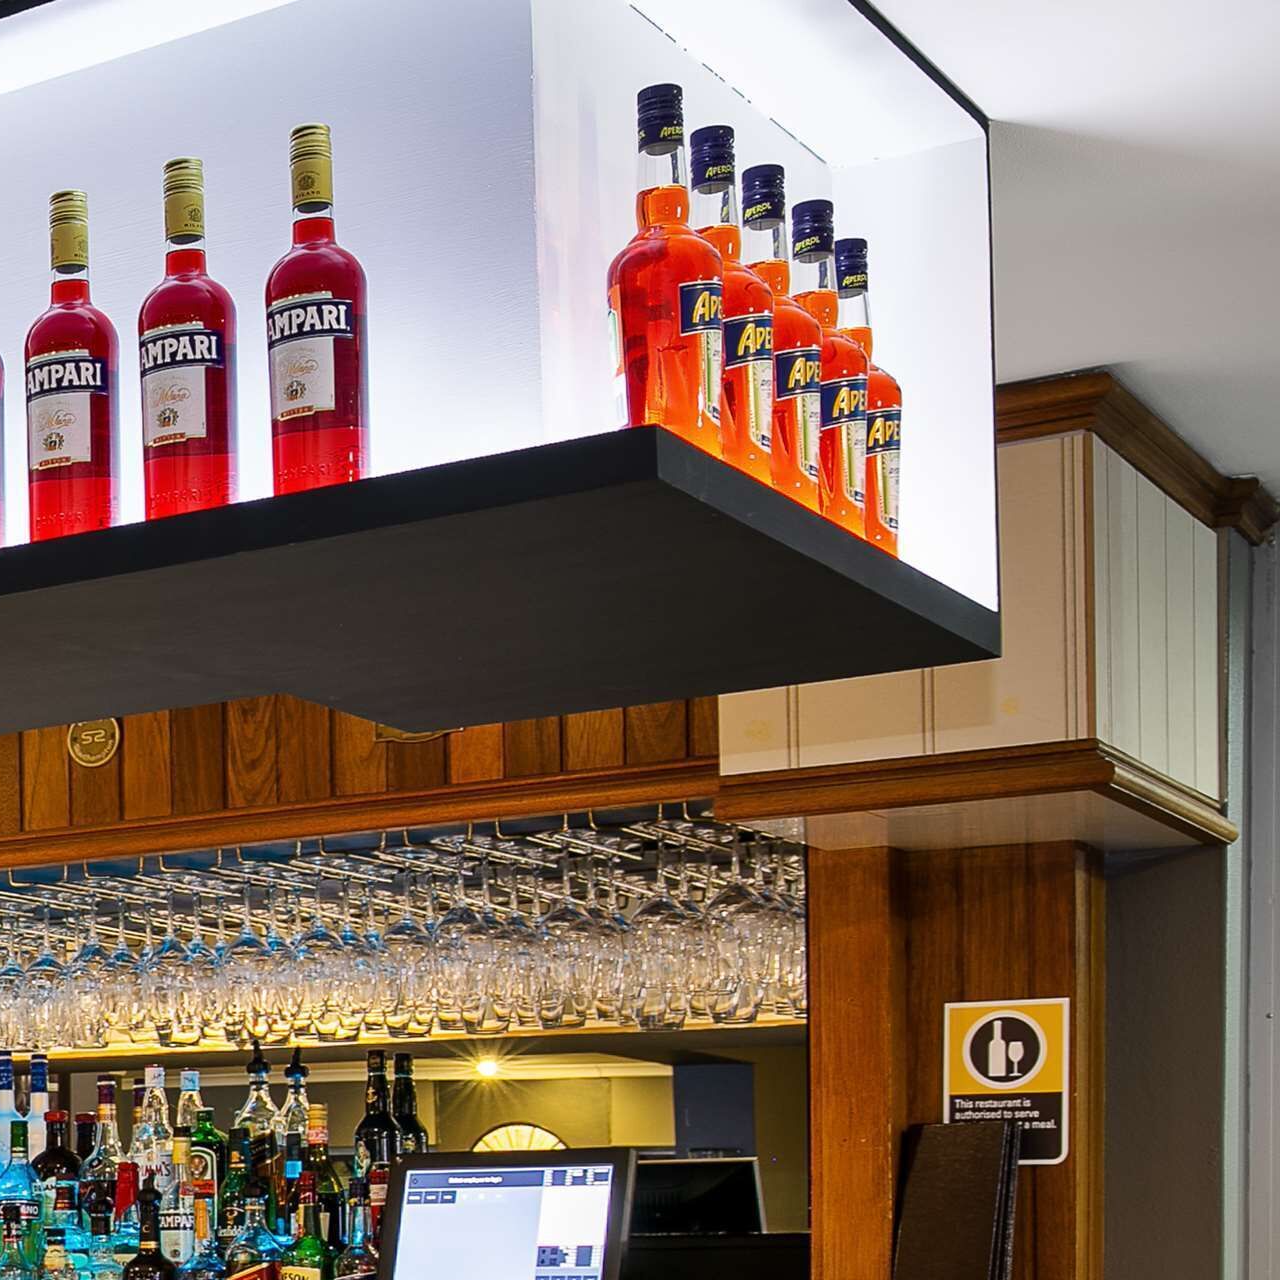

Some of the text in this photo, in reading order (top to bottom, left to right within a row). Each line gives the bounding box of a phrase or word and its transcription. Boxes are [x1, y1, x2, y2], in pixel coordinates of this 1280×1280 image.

[954, 1097, 1032, 1109] This restaurant is
[954, 1109, 1040, 1120] authorised to serve
[1023, 1121, 1030, 1129] a
